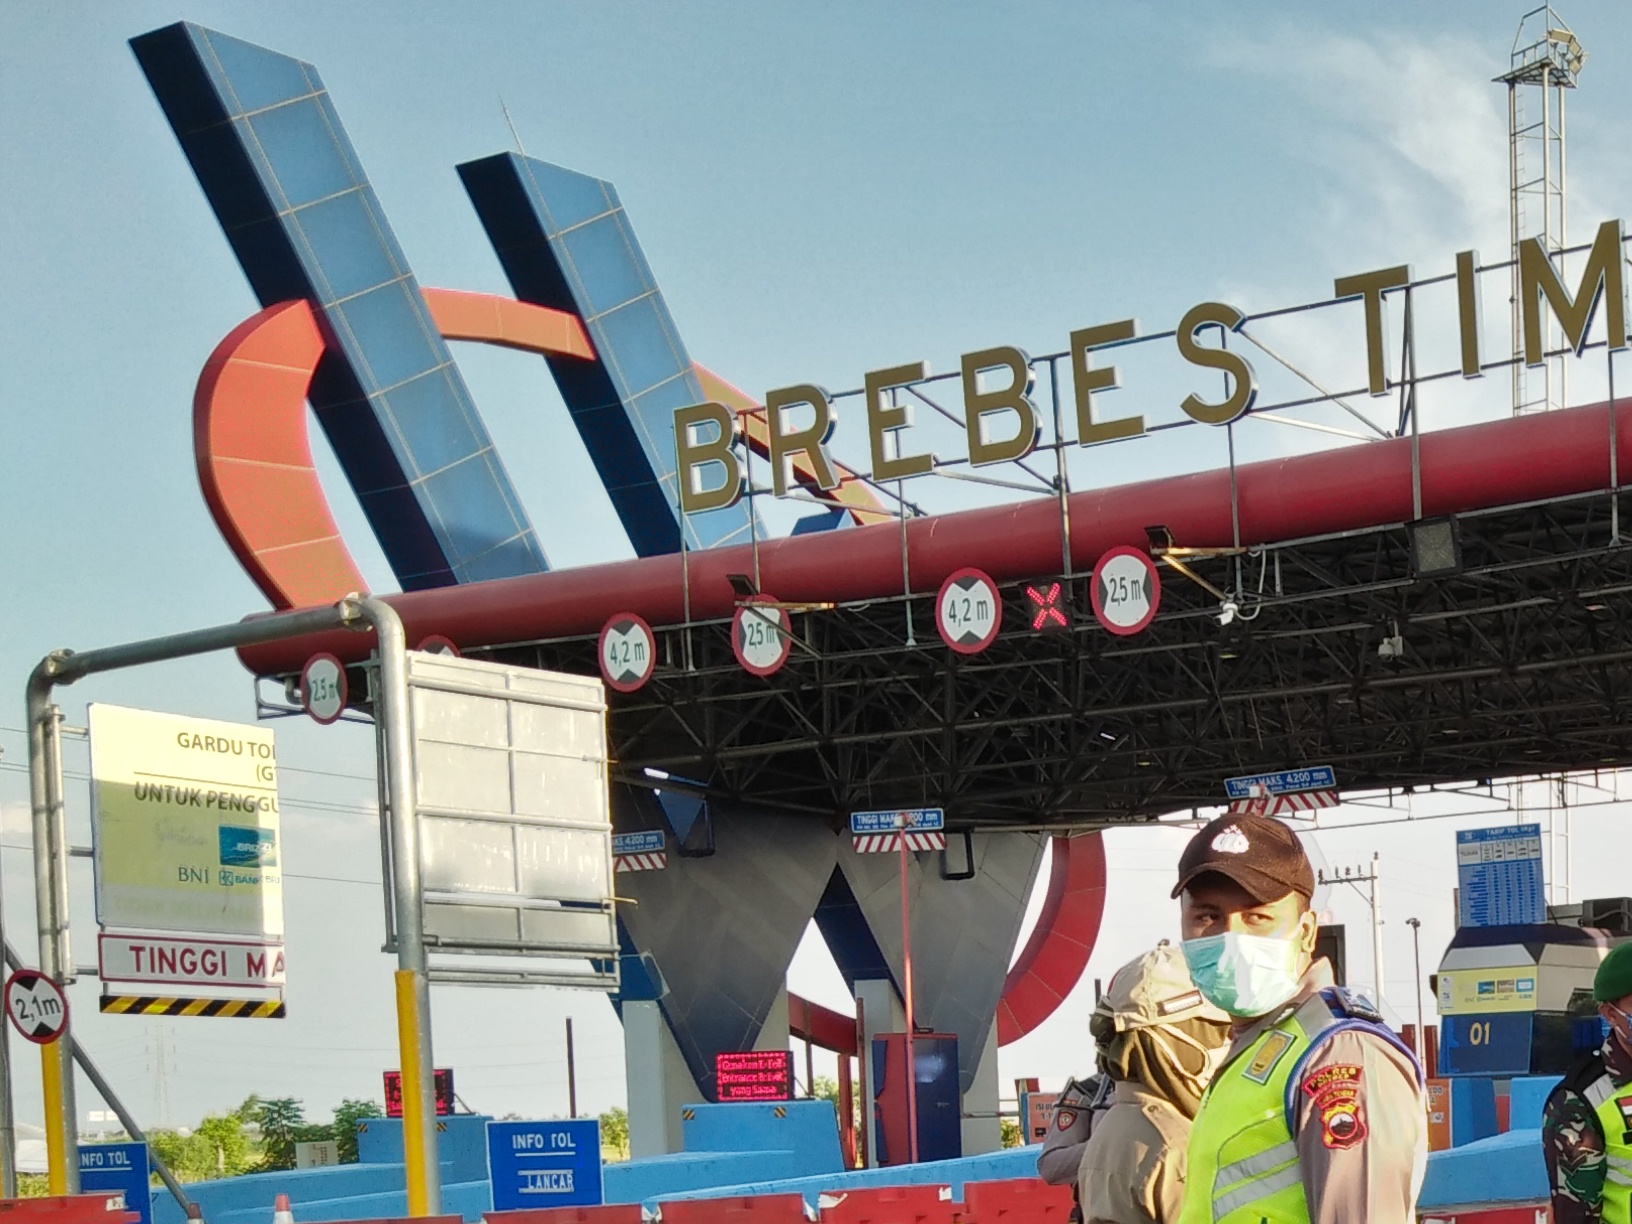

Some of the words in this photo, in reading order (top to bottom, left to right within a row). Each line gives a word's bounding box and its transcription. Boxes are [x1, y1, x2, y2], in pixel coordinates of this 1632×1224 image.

[672, 300, 1259, 515] BREBES
[1130, 579, 1141, 601] m
[948, 597, 972, 628] 4,2
[976, 599, 989, 621] m
[766, 624, 776, 644] m
[610, 640, 631, 668] 4,2
[634, 642, 645, 661] m
[176, 731, 244, 756] GARDU
[256, 764, 277, 782] (G
[1313, 772, 1327, 780] mm
[133, 780, 202, 807] UNTUK
[856, 814, 878, 826] TINGGI
[178, 867, 209, 884] BNI
[129, 944, 227, 977] TINGGI
[1469, 1021, 1490, 1046] 01
[512, 1133, 544, 1150] INFO
[550, 1131, 577, 1149] TOL
[80, 1152, 104, 1167] NFO
[107, 1150, 131, 1165] TOL
[527, 1173, 575, 1190] LANCAR
